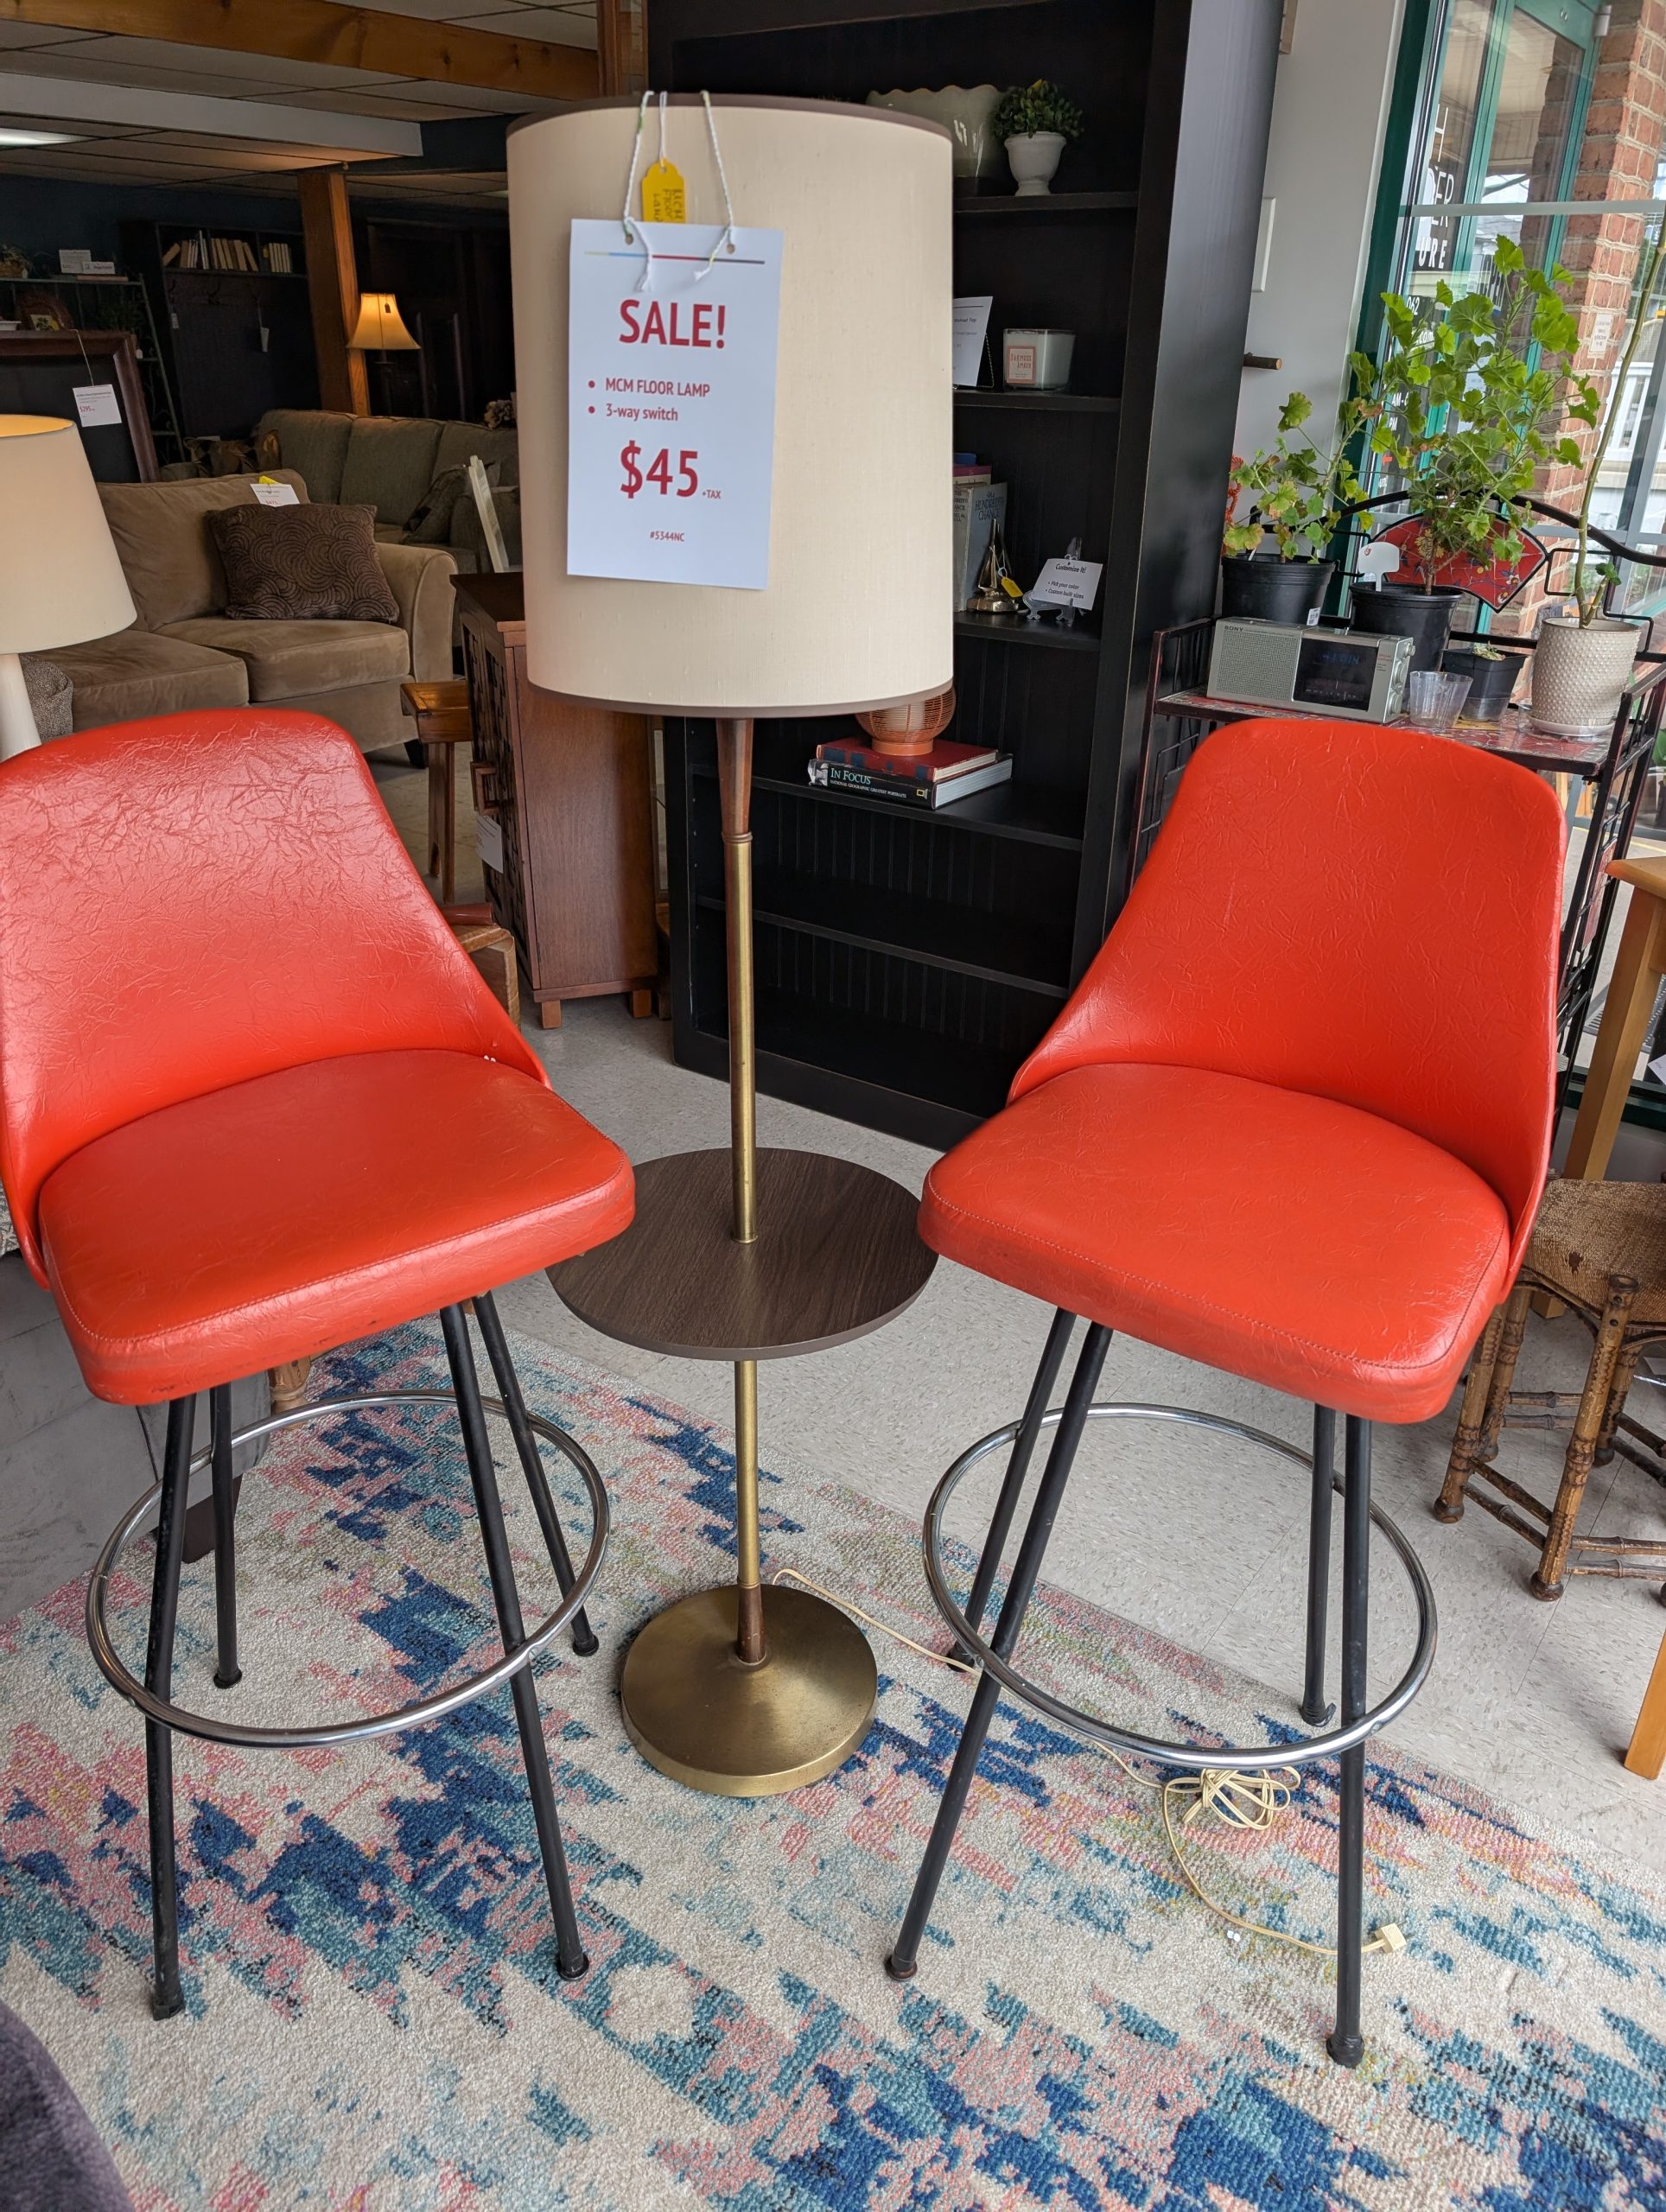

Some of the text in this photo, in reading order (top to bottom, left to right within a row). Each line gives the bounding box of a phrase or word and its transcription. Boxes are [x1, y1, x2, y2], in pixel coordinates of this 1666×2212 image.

[619, 299, 726, 349] SALE!
[606, 377, 710, 397] MCM FLOOR LAMP
[606, 403, 678, 422] 3-way switch
[620, 440, 722, 499] $45 +TAX
[650, 531, 685, 543] #5344NC
[1055, 563, 1080, 573] Customize
